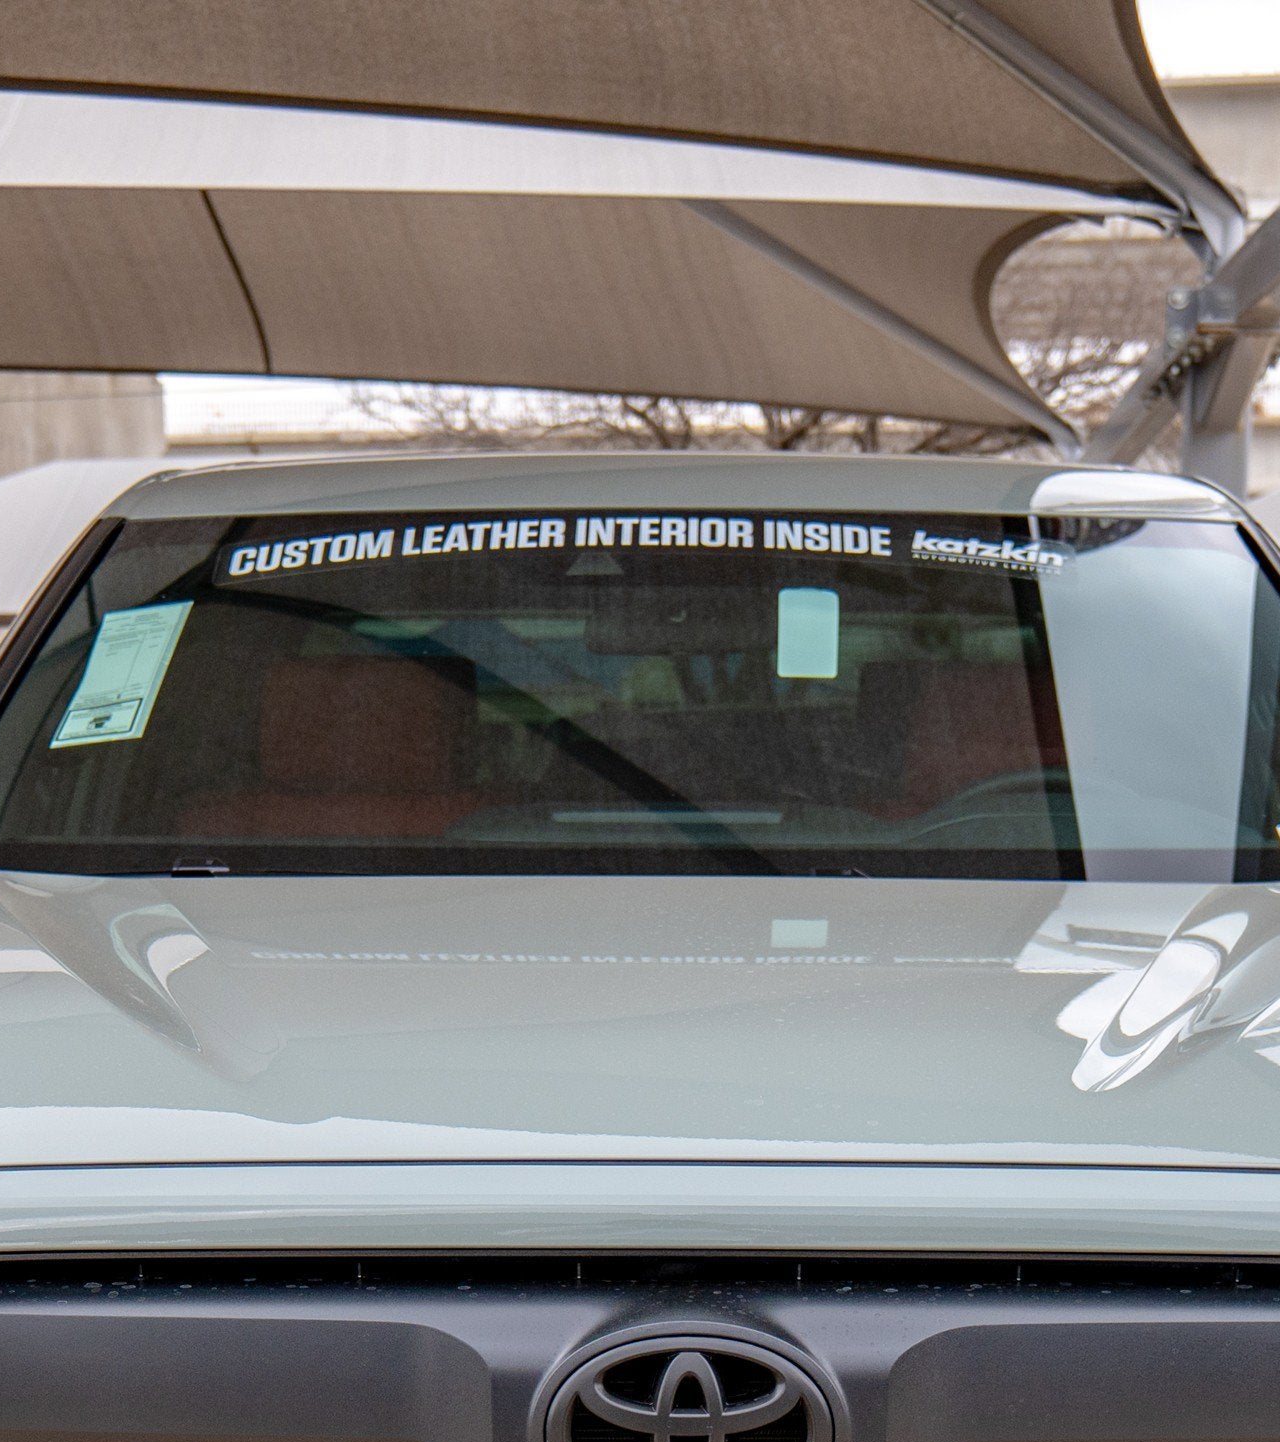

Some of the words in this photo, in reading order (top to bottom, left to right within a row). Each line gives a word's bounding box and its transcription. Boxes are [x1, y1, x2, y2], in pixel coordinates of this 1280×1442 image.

[228, 529, 395, 576] CUSTOM
[402, 518, 567, 556] LEATHER
[574, 517, 754, 548] INTERIOR
[763, 520, 892, 556] INSIDE
[911, 529, 1063, 567] katzkin
